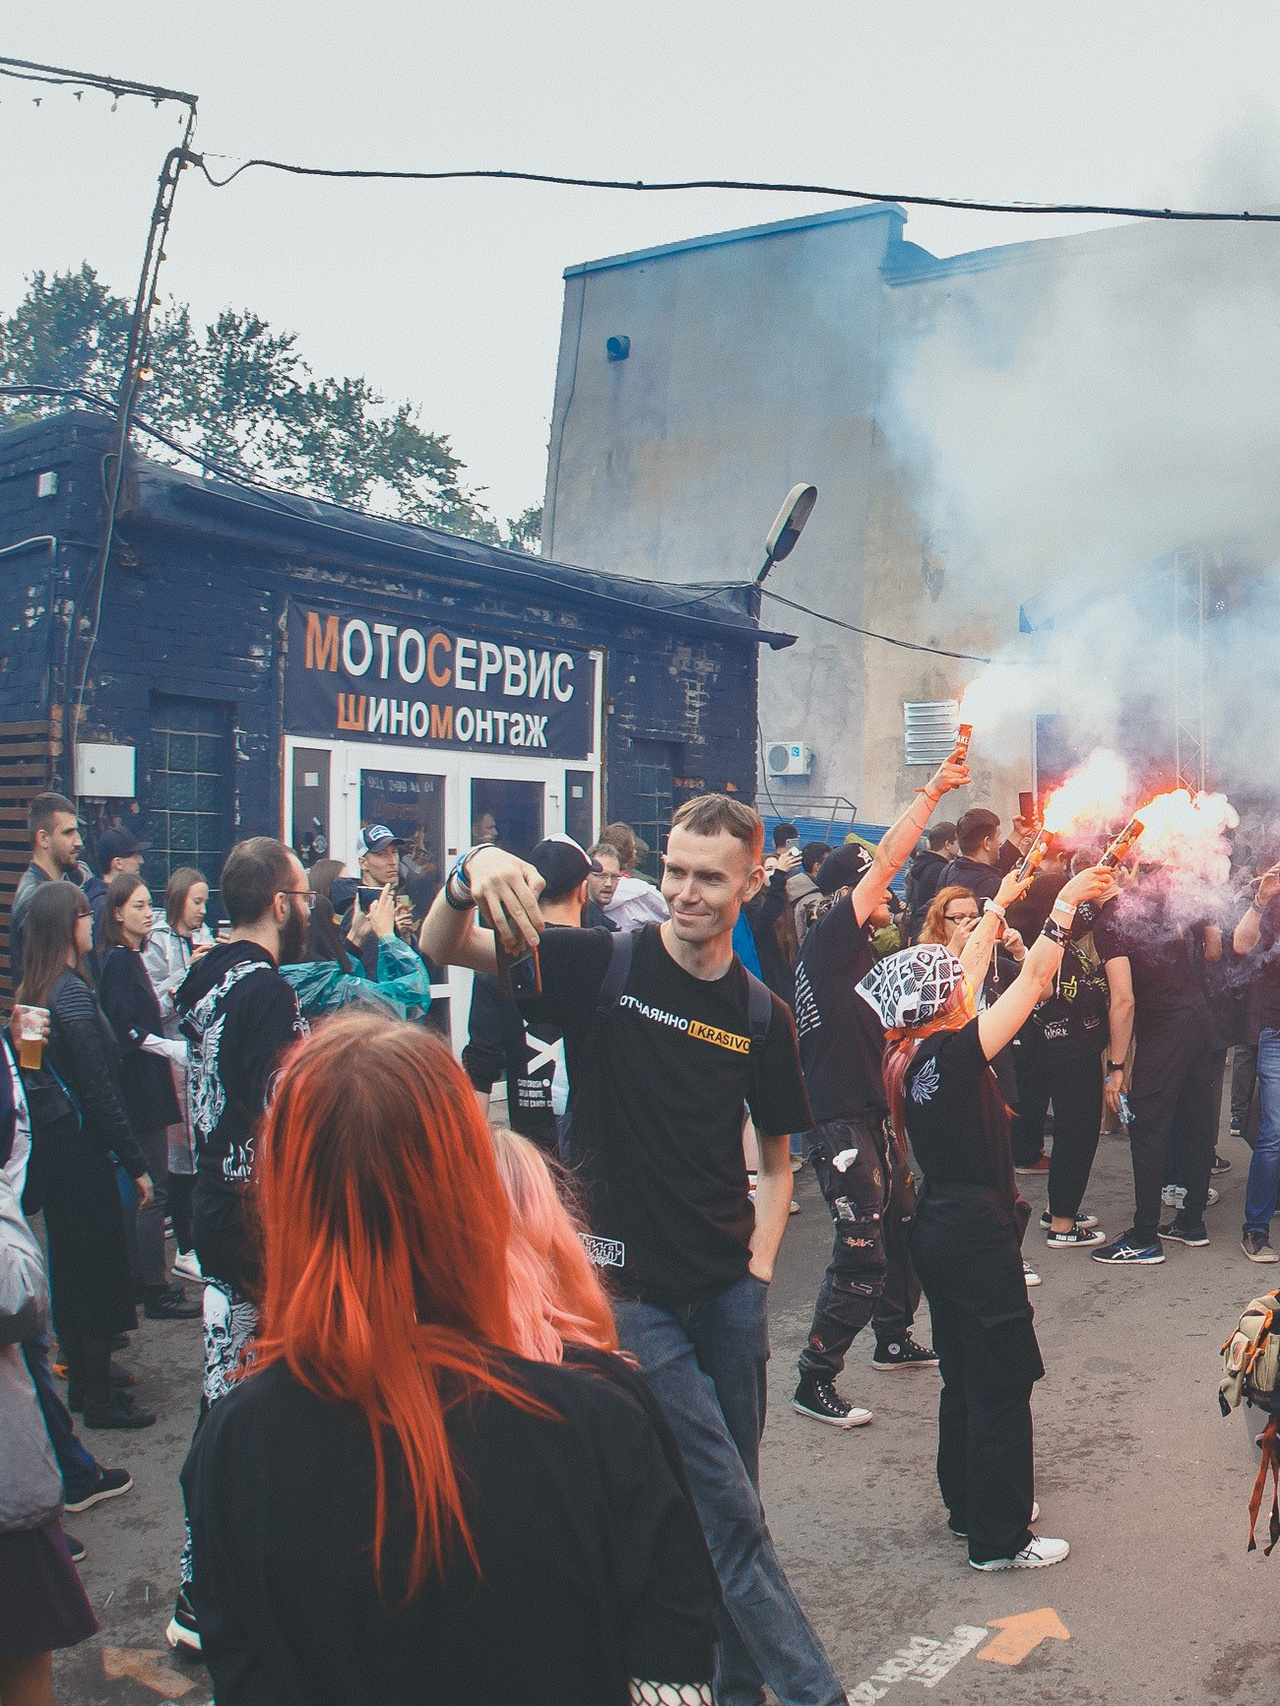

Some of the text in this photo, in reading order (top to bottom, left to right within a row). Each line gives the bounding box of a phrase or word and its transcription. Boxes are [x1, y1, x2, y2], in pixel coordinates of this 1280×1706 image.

[305, 611, 574, 703] МОТОСЕРВИС
[619, 994, 689, 1031] ОТЧАЯННО
[697, 1025, 750, 1052] KRASIVO
